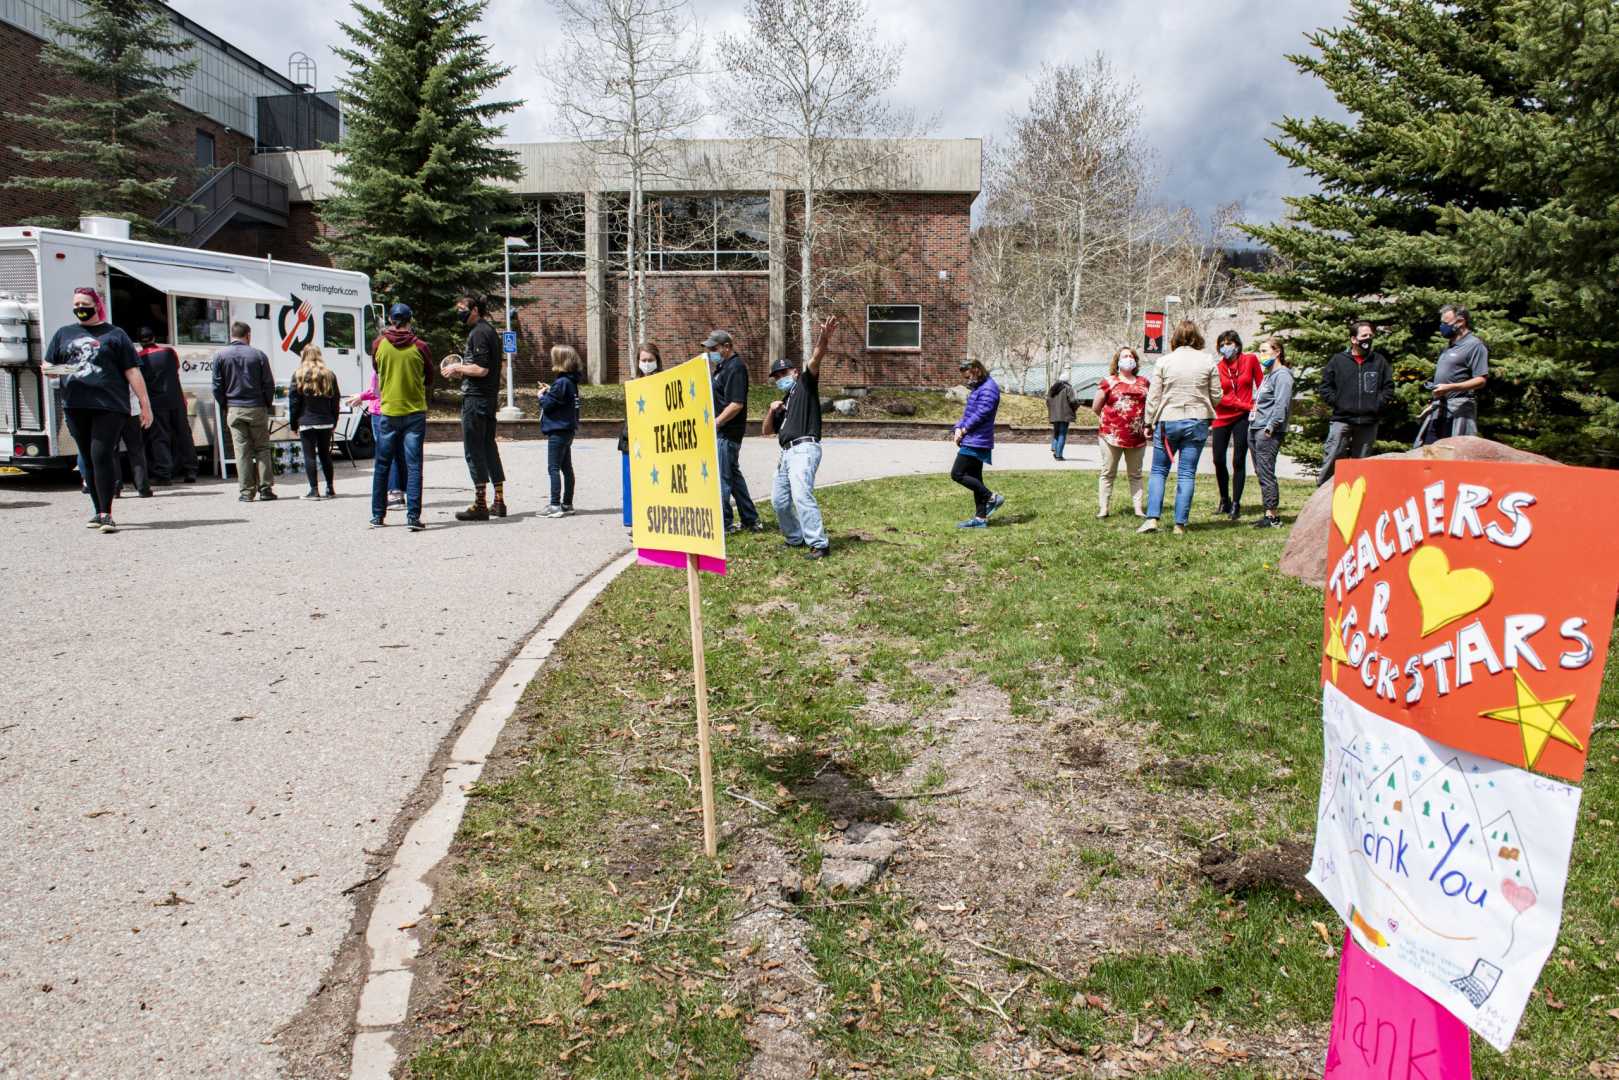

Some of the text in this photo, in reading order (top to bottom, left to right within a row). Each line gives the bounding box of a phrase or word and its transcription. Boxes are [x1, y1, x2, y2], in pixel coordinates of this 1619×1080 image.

[665, 379, 685, 412] OUR
[653, 418, 698, 454] TEACHERS
[671, 463, 688, 494] ARE
[646, 504, 715, 540] SUPERHEROES!
[1329, 480, 1537, 604] TEACHERS
[1368, 580, 1391, 640] R
[1340, 605, 1594, 704] ROCKSTARS
[1428, 811, 1488, 908] You
